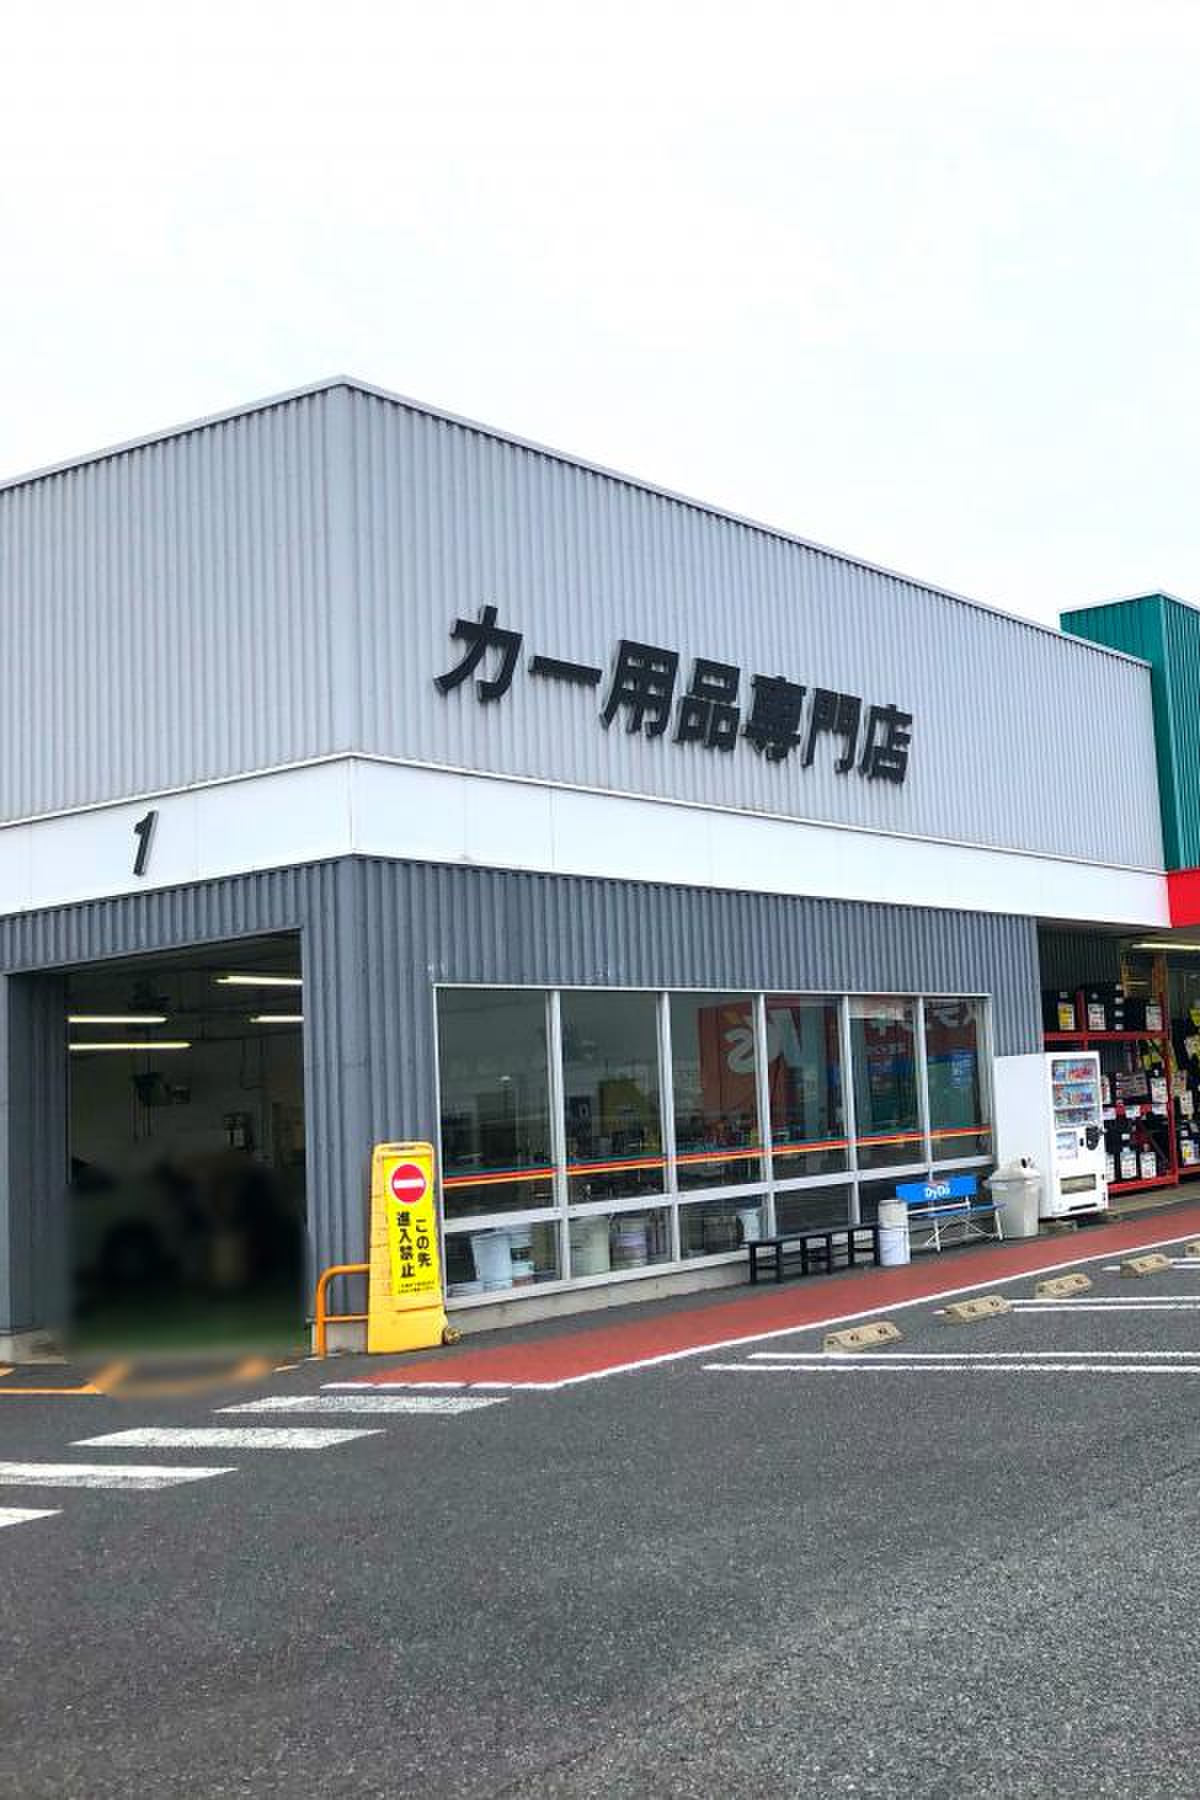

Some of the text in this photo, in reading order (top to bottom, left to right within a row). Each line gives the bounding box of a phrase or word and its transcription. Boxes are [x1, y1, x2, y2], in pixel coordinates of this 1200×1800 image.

[133, 810, 158, 877] 1
[397, 1211, 415, 1279] 進入禁止
[415, 1218, 432, 1268] この先
